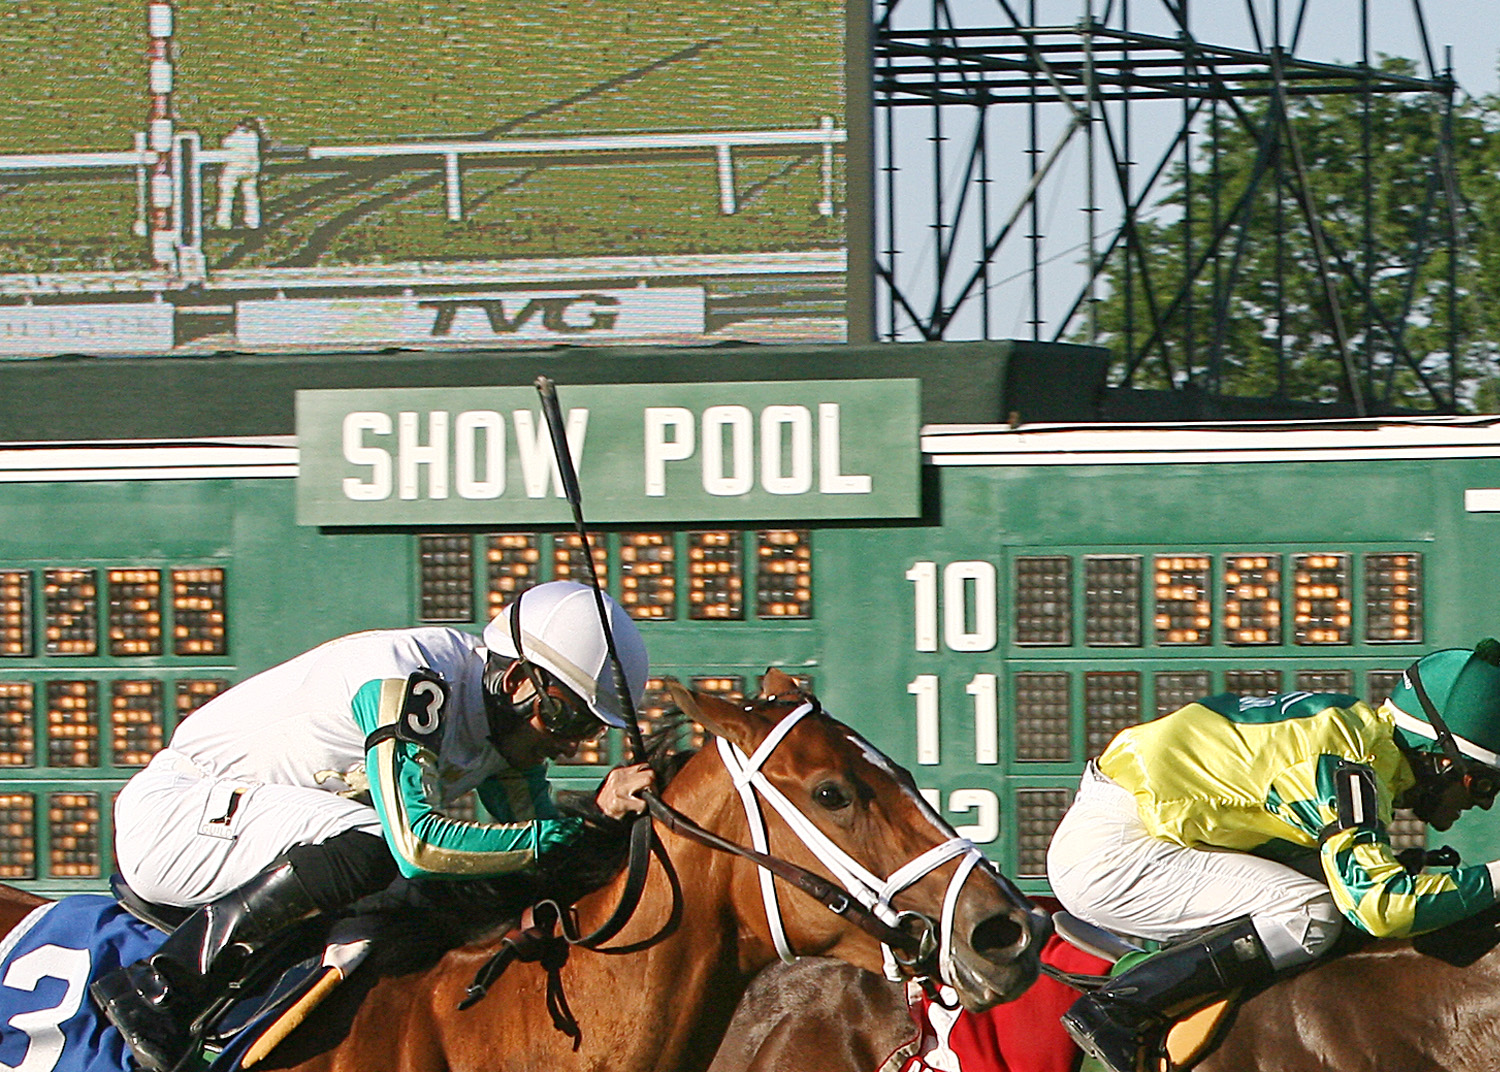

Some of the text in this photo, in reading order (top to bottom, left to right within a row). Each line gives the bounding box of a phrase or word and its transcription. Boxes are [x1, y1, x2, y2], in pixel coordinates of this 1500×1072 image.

[416, 294, 621, 337] TVG
[342, 403, 873, 501] SHOW POOL
[906, 561, 997, 652] 10
[407, 681, 444, 735] 3
[907, 674, 998, 765] 11
[1350, 774, 1364, 824] 1
